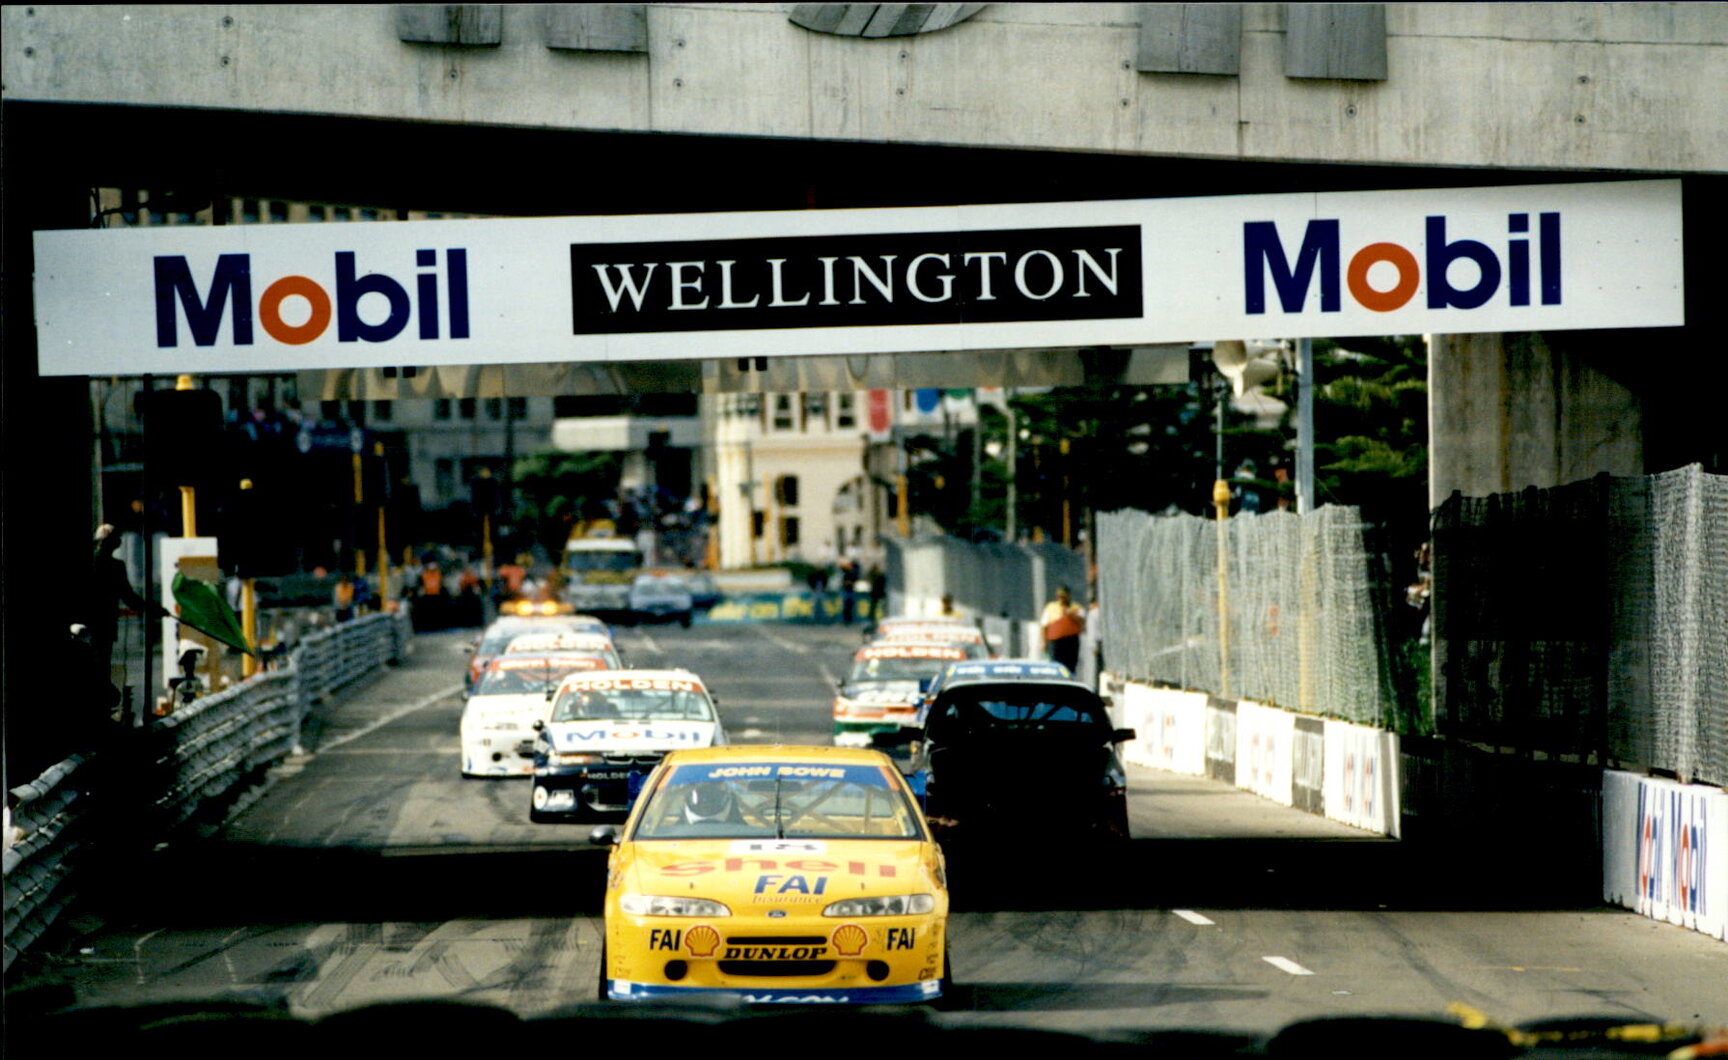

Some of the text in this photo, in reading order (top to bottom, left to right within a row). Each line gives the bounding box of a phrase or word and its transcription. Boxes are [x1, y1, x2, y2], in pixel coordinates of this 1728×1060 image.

[1243, 211, 1562, 316] Mobil
[591, 247, 1123, 313] WELLINGTON
[153, 247, 470, 348] Mobil
[569, 680, 694, 693] HOLDEN
[565, 729, 701, 744] Mobil
[708, 766, 846, 779] JOHN BOWE
[754, 874, 828, 895] FAI
[650, 928, 682, 951] FAI
[887, 927, 915, 951] FAI
[723, 947, 828, 960] DUNLOP
